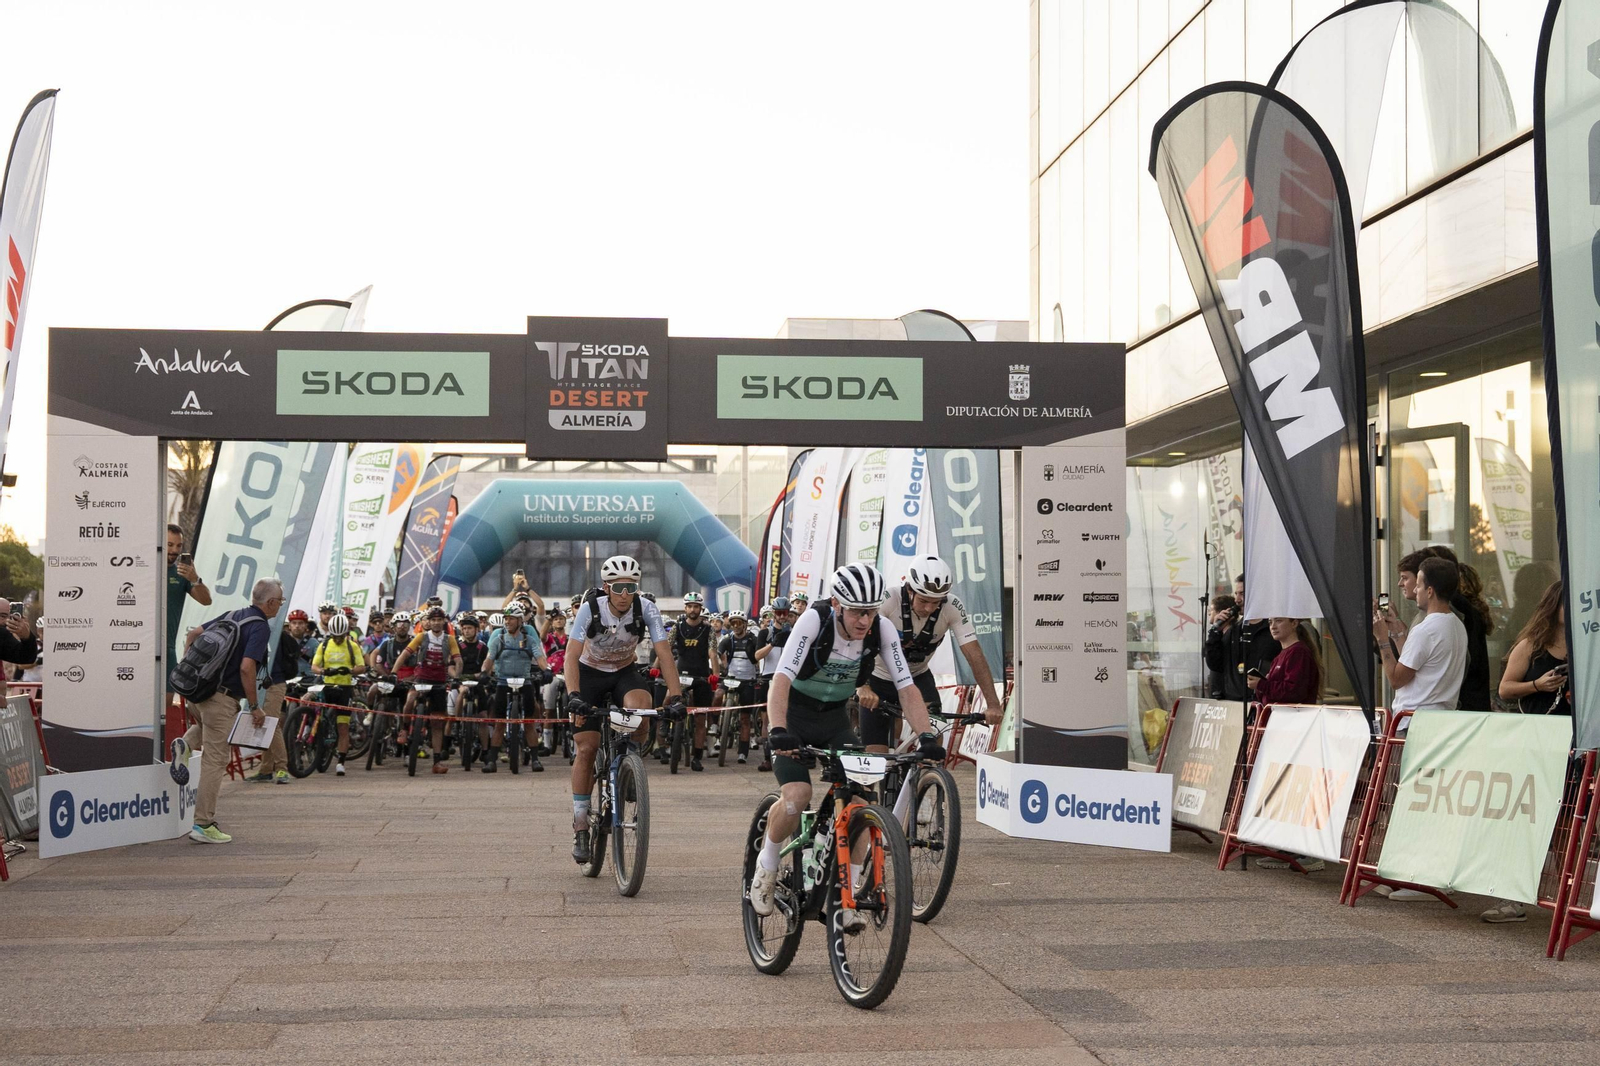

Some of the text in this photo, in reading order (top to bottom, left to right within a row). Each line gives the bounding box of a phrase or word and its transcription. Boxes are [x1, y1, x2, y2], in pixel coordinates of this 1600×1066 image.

[134, 347, 250, 376] Andalucía
[535, 342, 649, 380] TITAN
[550, 390, 649, 407] DESERT
[946, 405, 1092, 418] DIPUTACIÓN DE ALMERÍA
[561, 413, 632, 427] ALMERÍA
[88, 468, 129, 478] ALMERÍA
[1062, 464, 1105, 474] ALMERÍA
[92, 500, 127, 508] EJÉRCITO
[523, 494, 656, 512] UNIVERSAE
[1056, 502, 1113, 512] Cleardent
[215, 442, 288, 601] SKO
[523, 513, 655, 525] Instituto Superior de FP
[107, 522, 120, 538] DE
[857, 757, 871, 766] 14
[987, 781, 1010, 811] Cleardent
[80, 790, 170, 825] Cleardent
[1055, 793, 1161, 826] Cleardent
